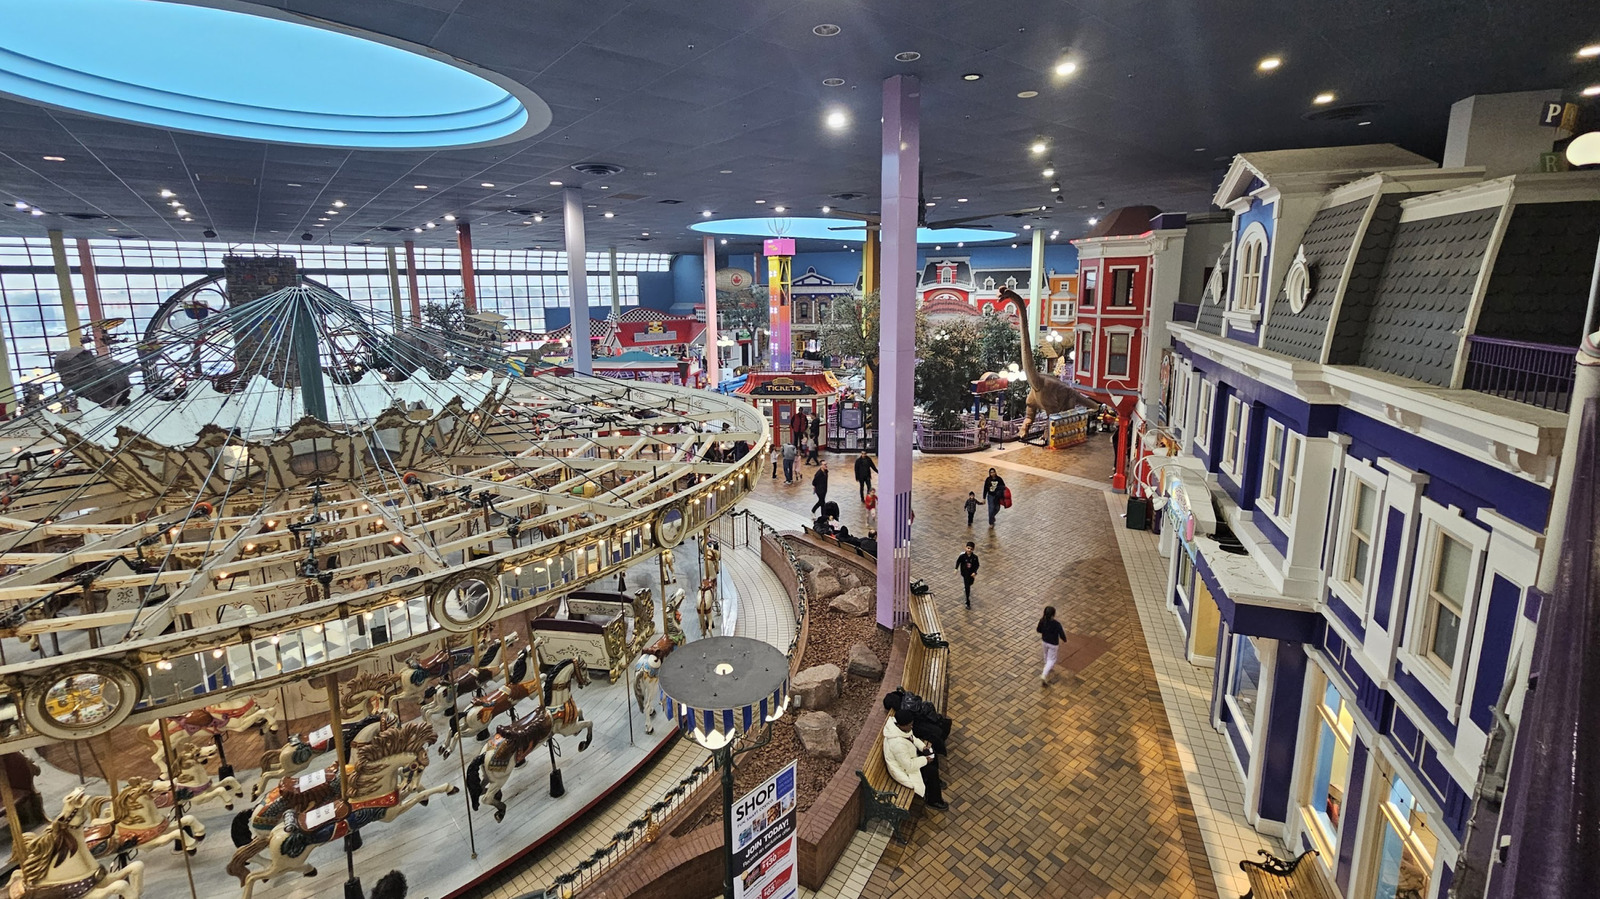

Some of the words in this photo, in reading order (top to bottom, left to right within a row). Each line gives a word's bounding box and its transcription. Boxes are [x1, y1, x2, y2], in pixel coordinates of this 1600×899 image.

[1545, 104, 1561, 123] P
[1545, 155, 1557, 171] R
[736, 782, 775, 822] SHOP
[745, 838, 762, 858] JOIN
[763, 818, 789, 843] TODAY!
